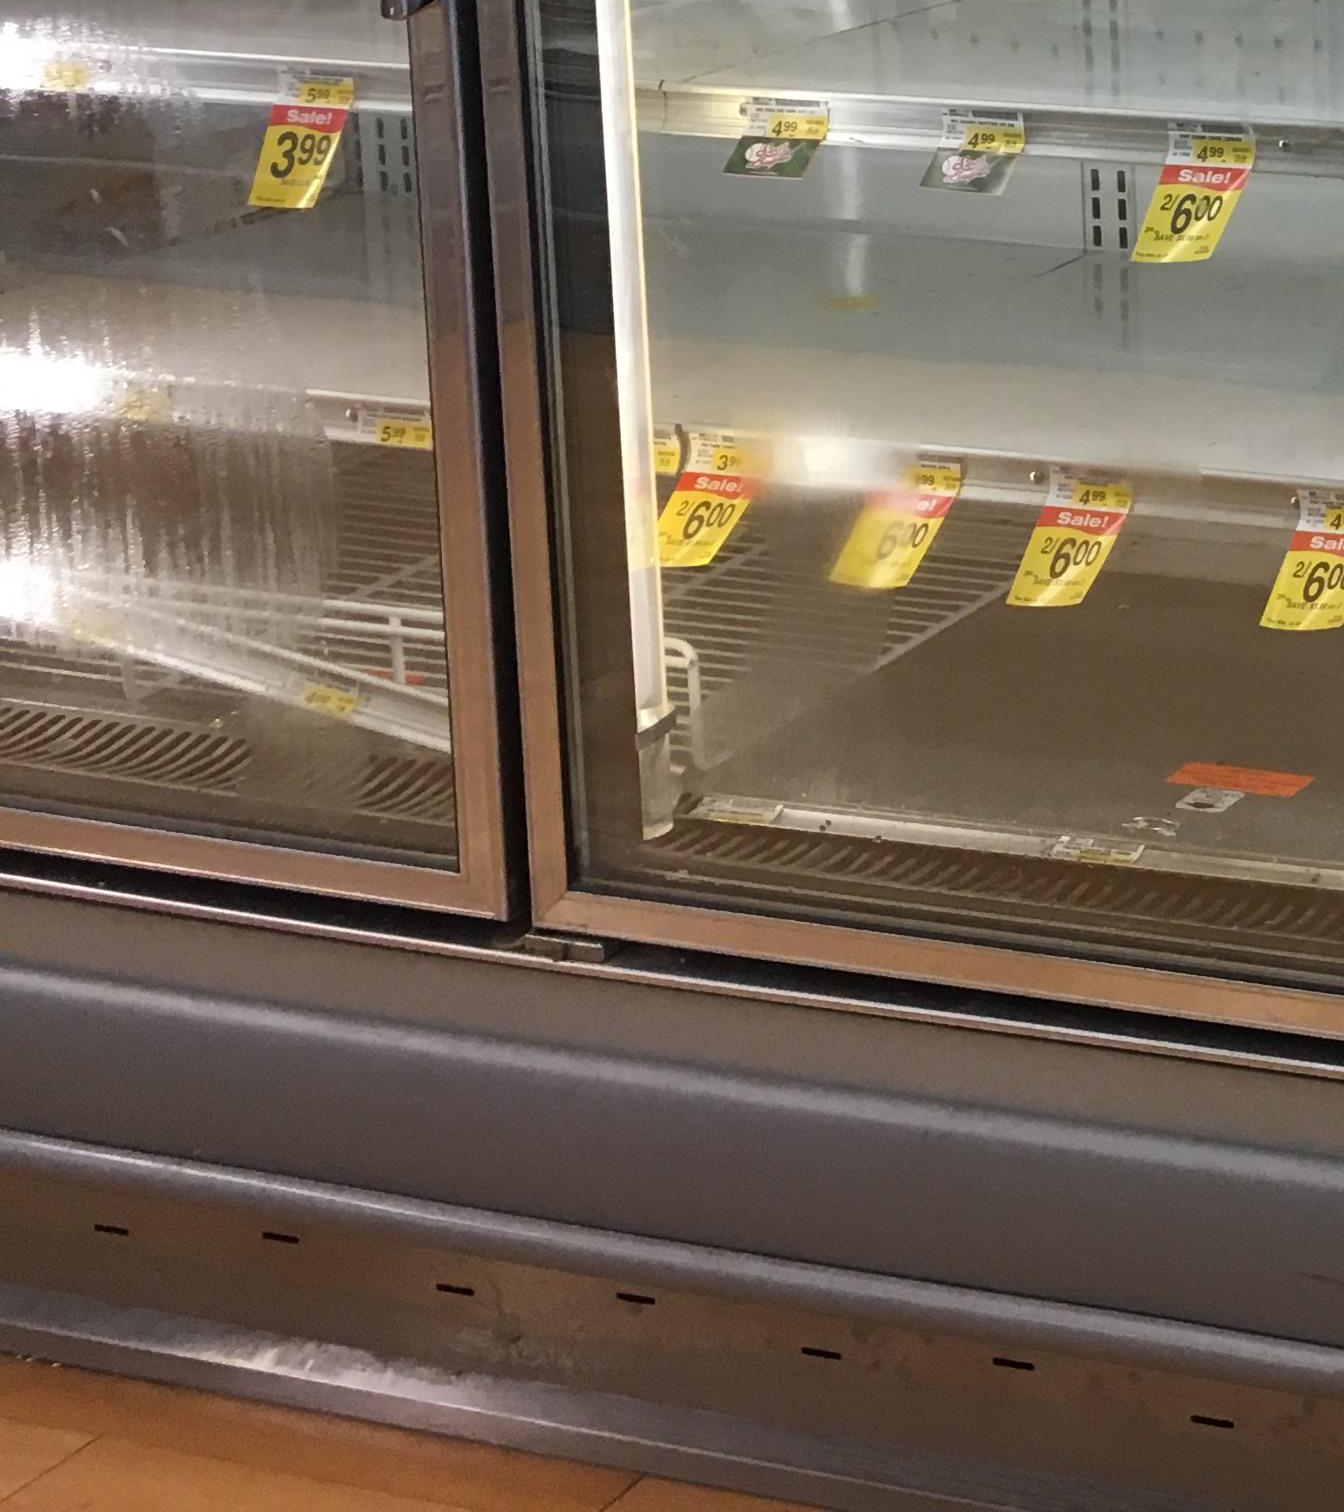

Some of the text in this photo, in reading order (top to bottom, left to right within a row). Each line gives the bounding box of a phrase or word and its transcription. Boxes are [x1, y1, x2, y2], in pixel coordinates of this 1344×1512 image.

[287, 109, 331, 125] Sale!
[771, 120, 797, 137] 499
[967, 132, 995, 149] 499
[270, 131, 332, 179] 399
[1196, 145, 1223, 162] 499
[1178, 168, 1232, 185] Sale!
[694, 476, 742, 493] Sale!
[1079, 489, 1106, 505] 499
[1056, 511, 1109, 528] Sale!
[1041, 537, 1102, 579] 2/600
